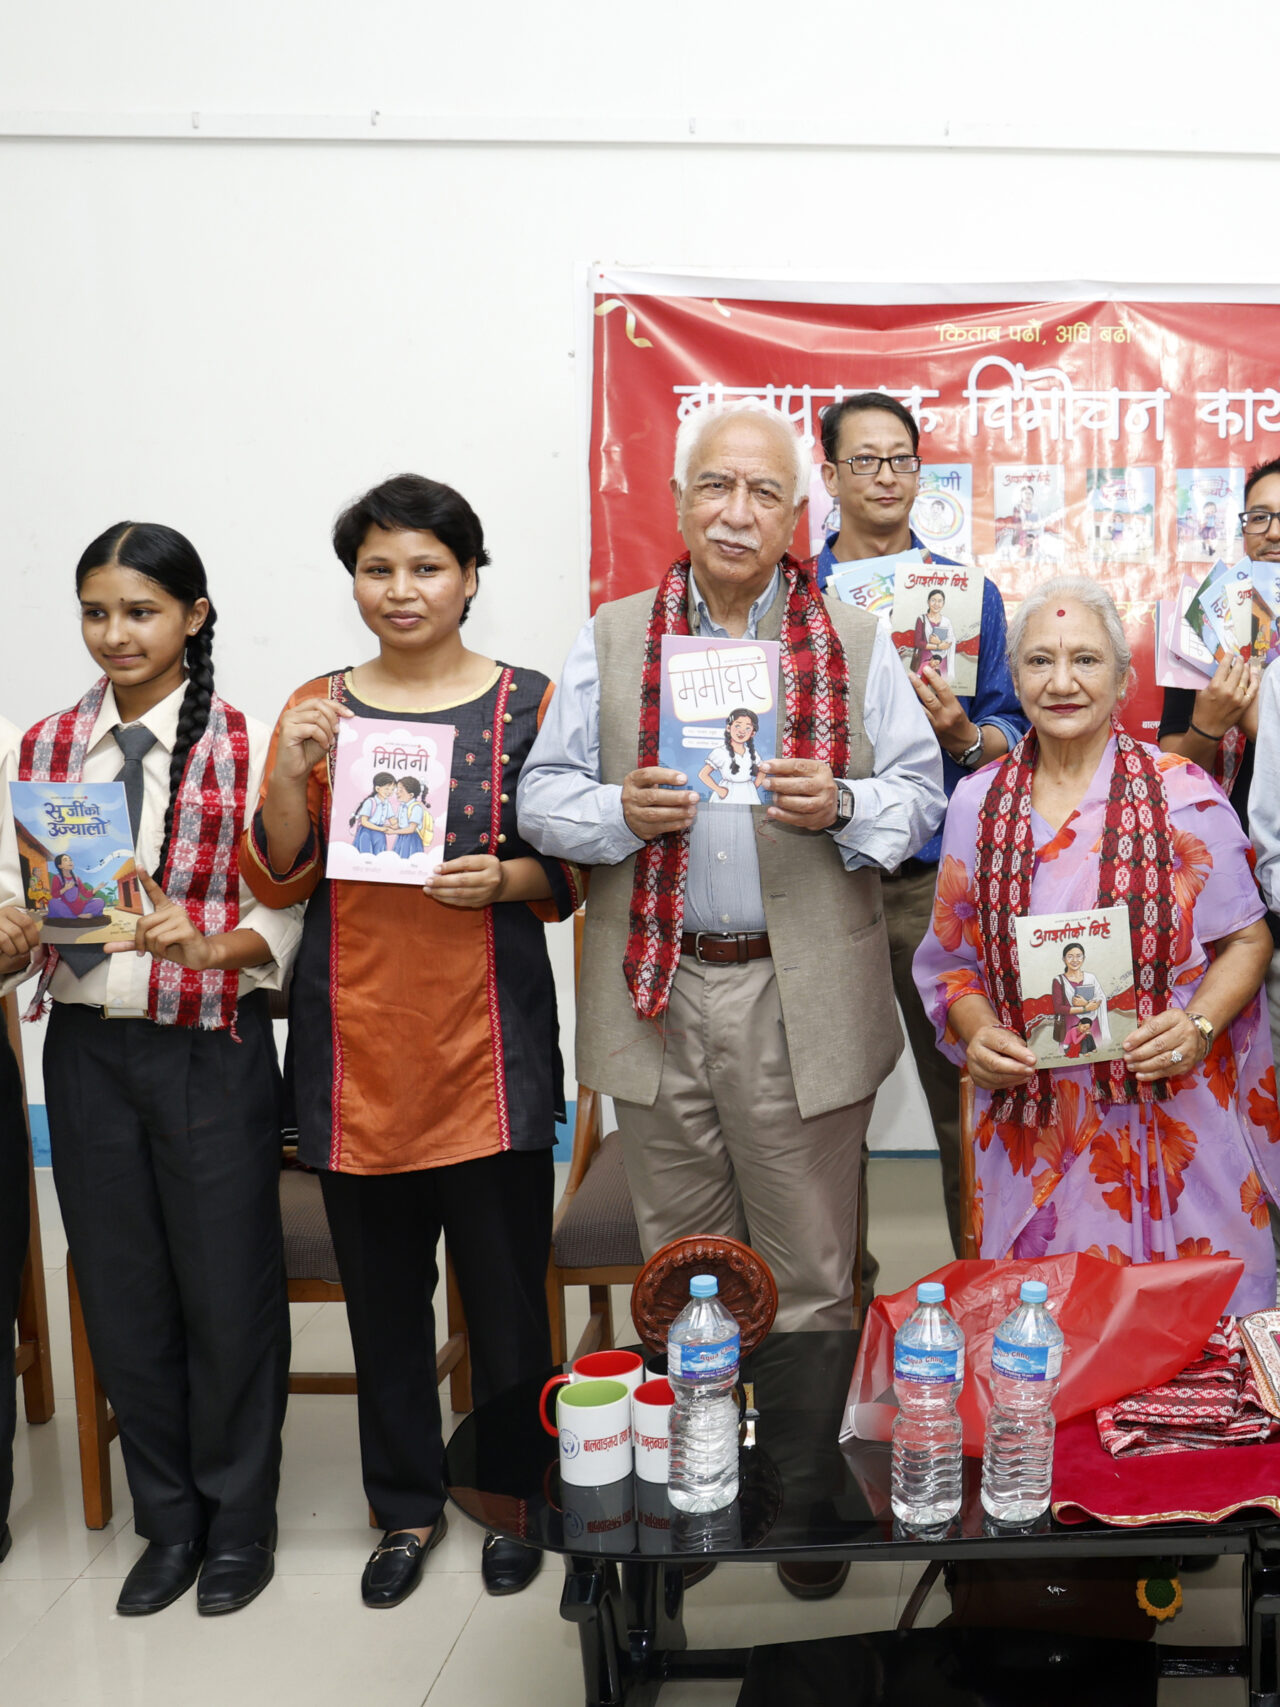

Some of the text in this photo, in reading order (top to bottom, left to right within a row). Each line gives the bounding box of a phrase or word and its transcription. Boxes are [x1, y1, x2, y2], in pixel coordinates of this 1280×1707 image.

[1056, 322, 1091, 343] अघि
[372, 746, 431, 772] मितिनी
[47, 816, 111, 837] उज्यालो
